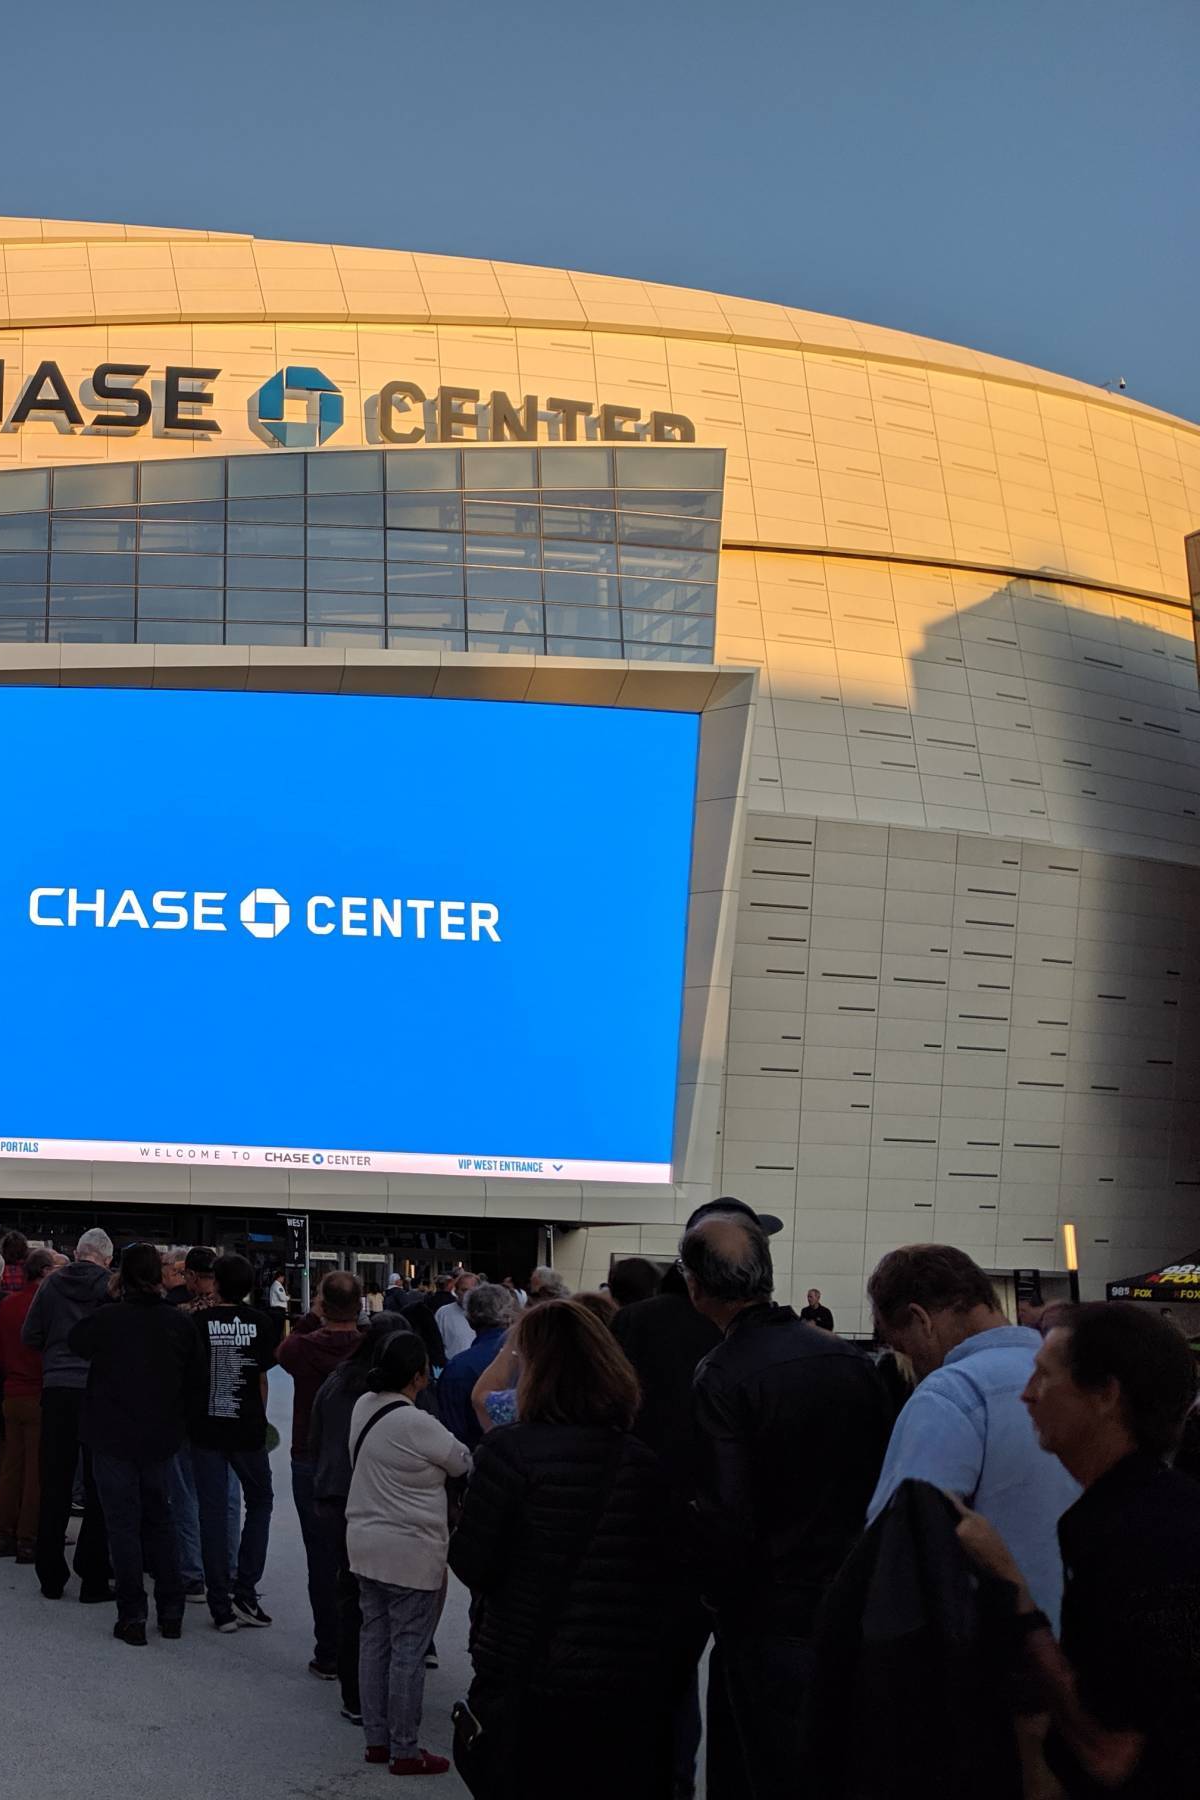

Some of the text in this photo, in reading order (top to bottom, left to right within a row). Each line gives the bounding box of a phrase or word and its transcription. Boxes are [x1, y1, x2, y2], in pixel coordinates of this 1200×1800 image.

[29, 887, 502, 942] CHASE CENTER
[0, 1142, 39, 1153] PORTALS
[140, 1147, 372, 1166] WELCOME TO CHASE CENTER
[458, 1158, 544, 1173] VIP WEST ENTRANCE
[287, 1218, 305, 1228] WEST
[208, 1317, 258, 1338] Moving
[235, 1334, 251, 1346] on
